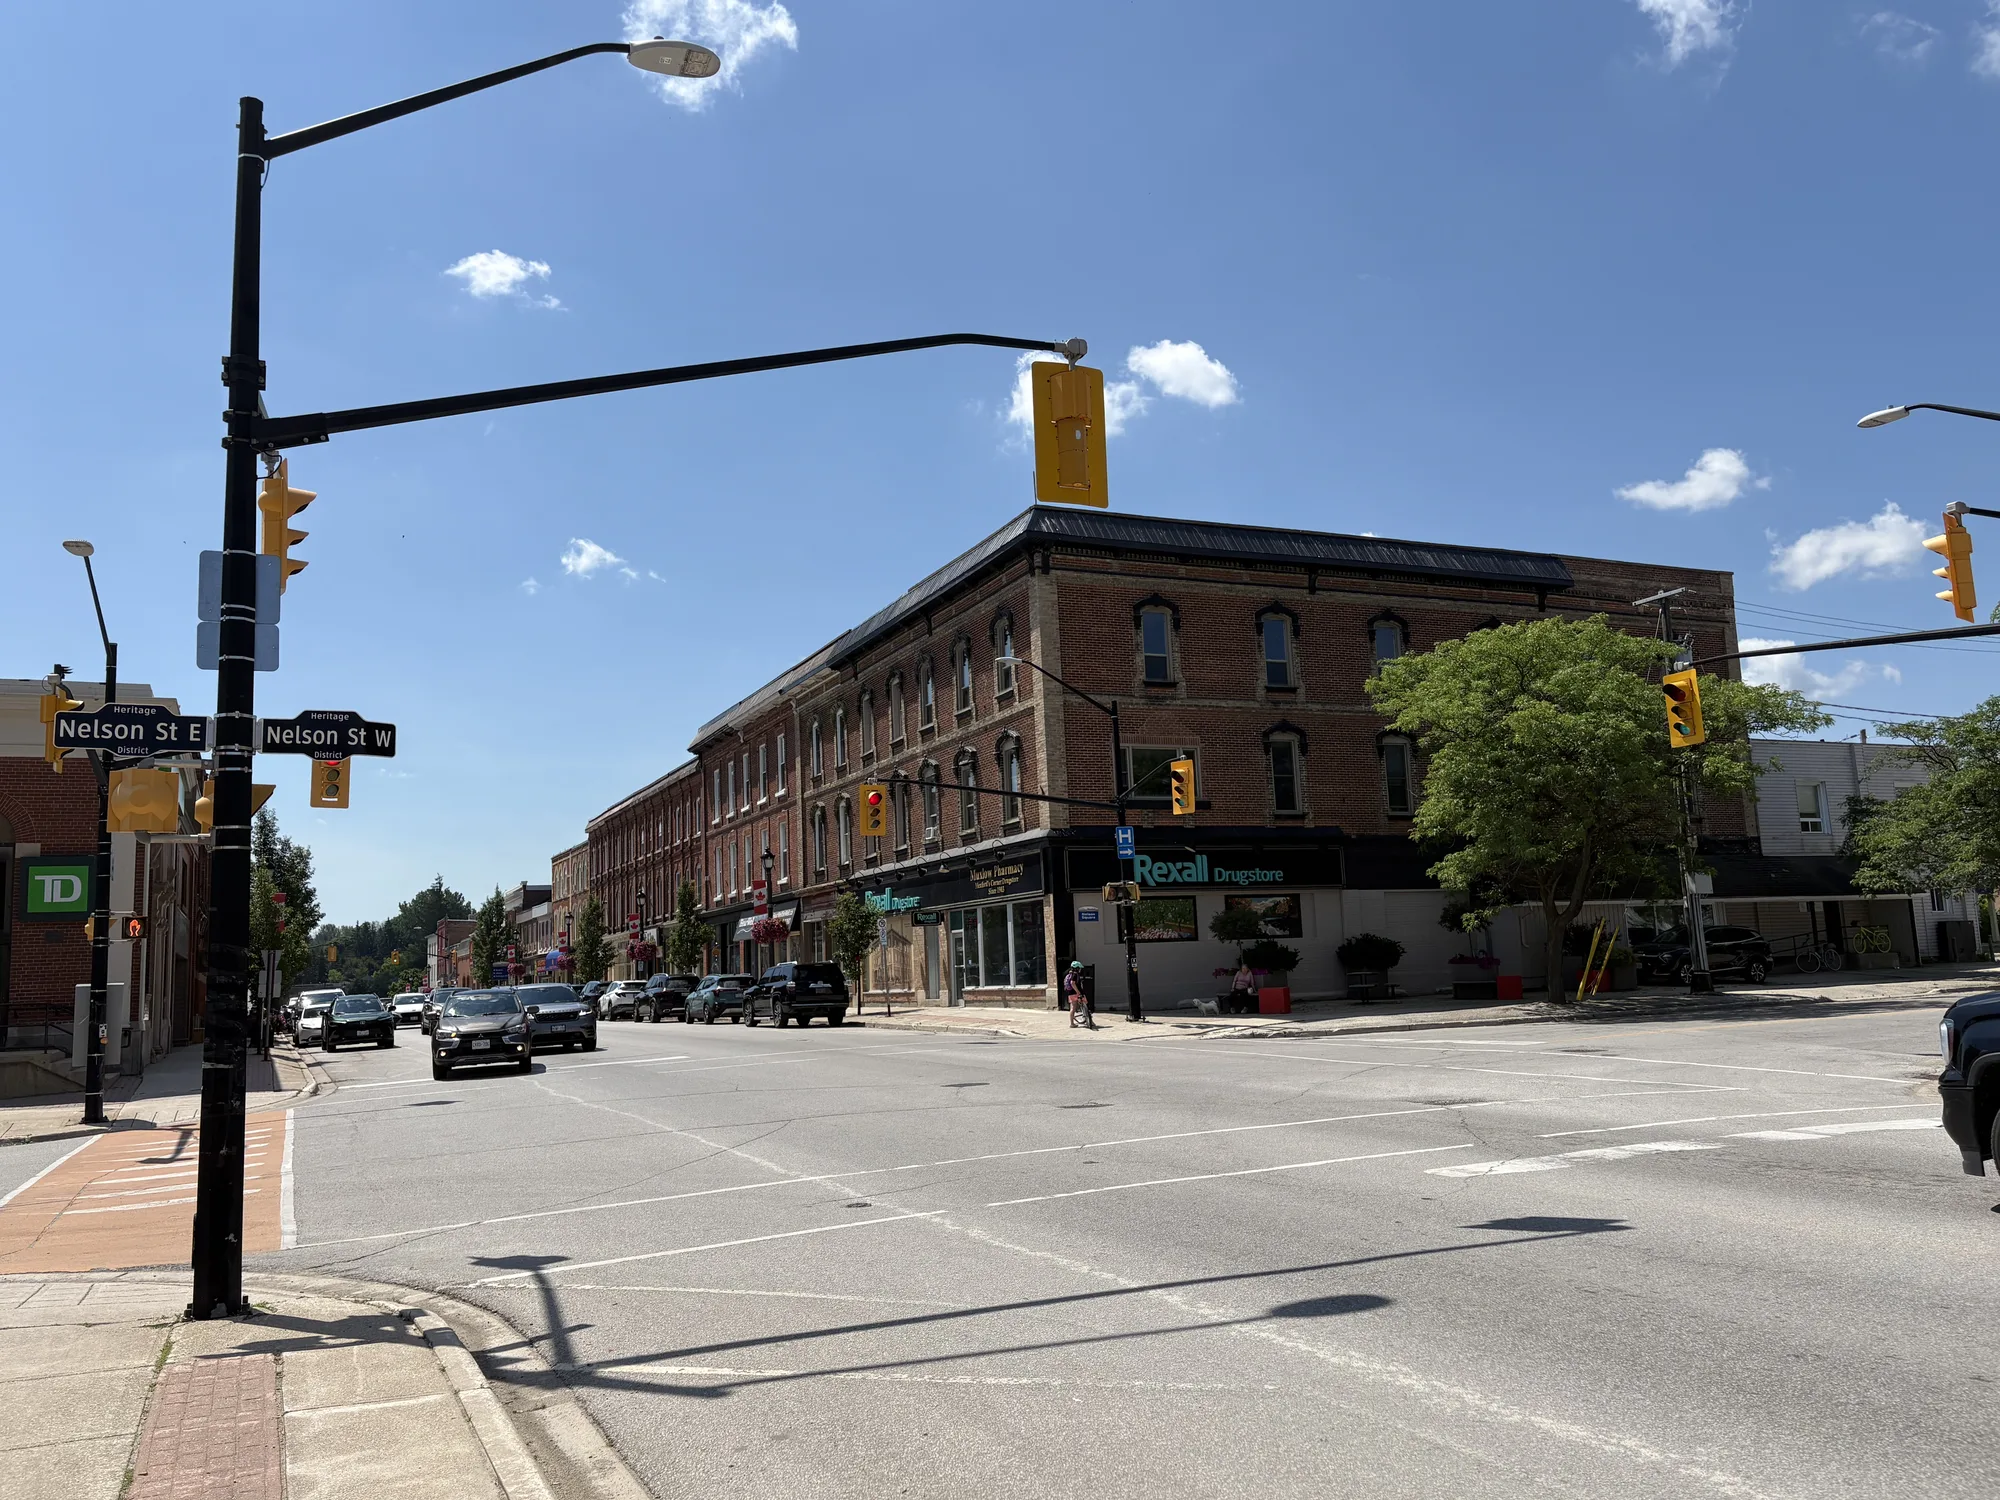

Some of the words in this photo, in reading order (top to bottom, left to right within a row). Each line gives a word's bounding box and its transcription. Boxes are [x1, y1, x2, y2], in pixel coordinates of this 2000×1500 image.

[113, 705, 157, 717] Heritage
[311, 712, 350, 722] Heritage
[59, 719, 144, 740] Nelson
[155, 722, 178, 741] St
[189, 723, 201, 742] E
[267, 725, 338, 745] Nelson
[347, 727, 367, 746] St
[375, 729, 392, 748] W
[117, 746, 149, 755] District
[314, 751, 343, 759] District
[1118, 829, 1132, 844] H
[993, 863, 1024, 877] Pharmacy
[1133, 854, 1209, 887] Rexall
[1214, 867, 1284, 885] Drugstore
[34, 874, 82, 903] TD
[917, 912, 937, 921] Rexall
